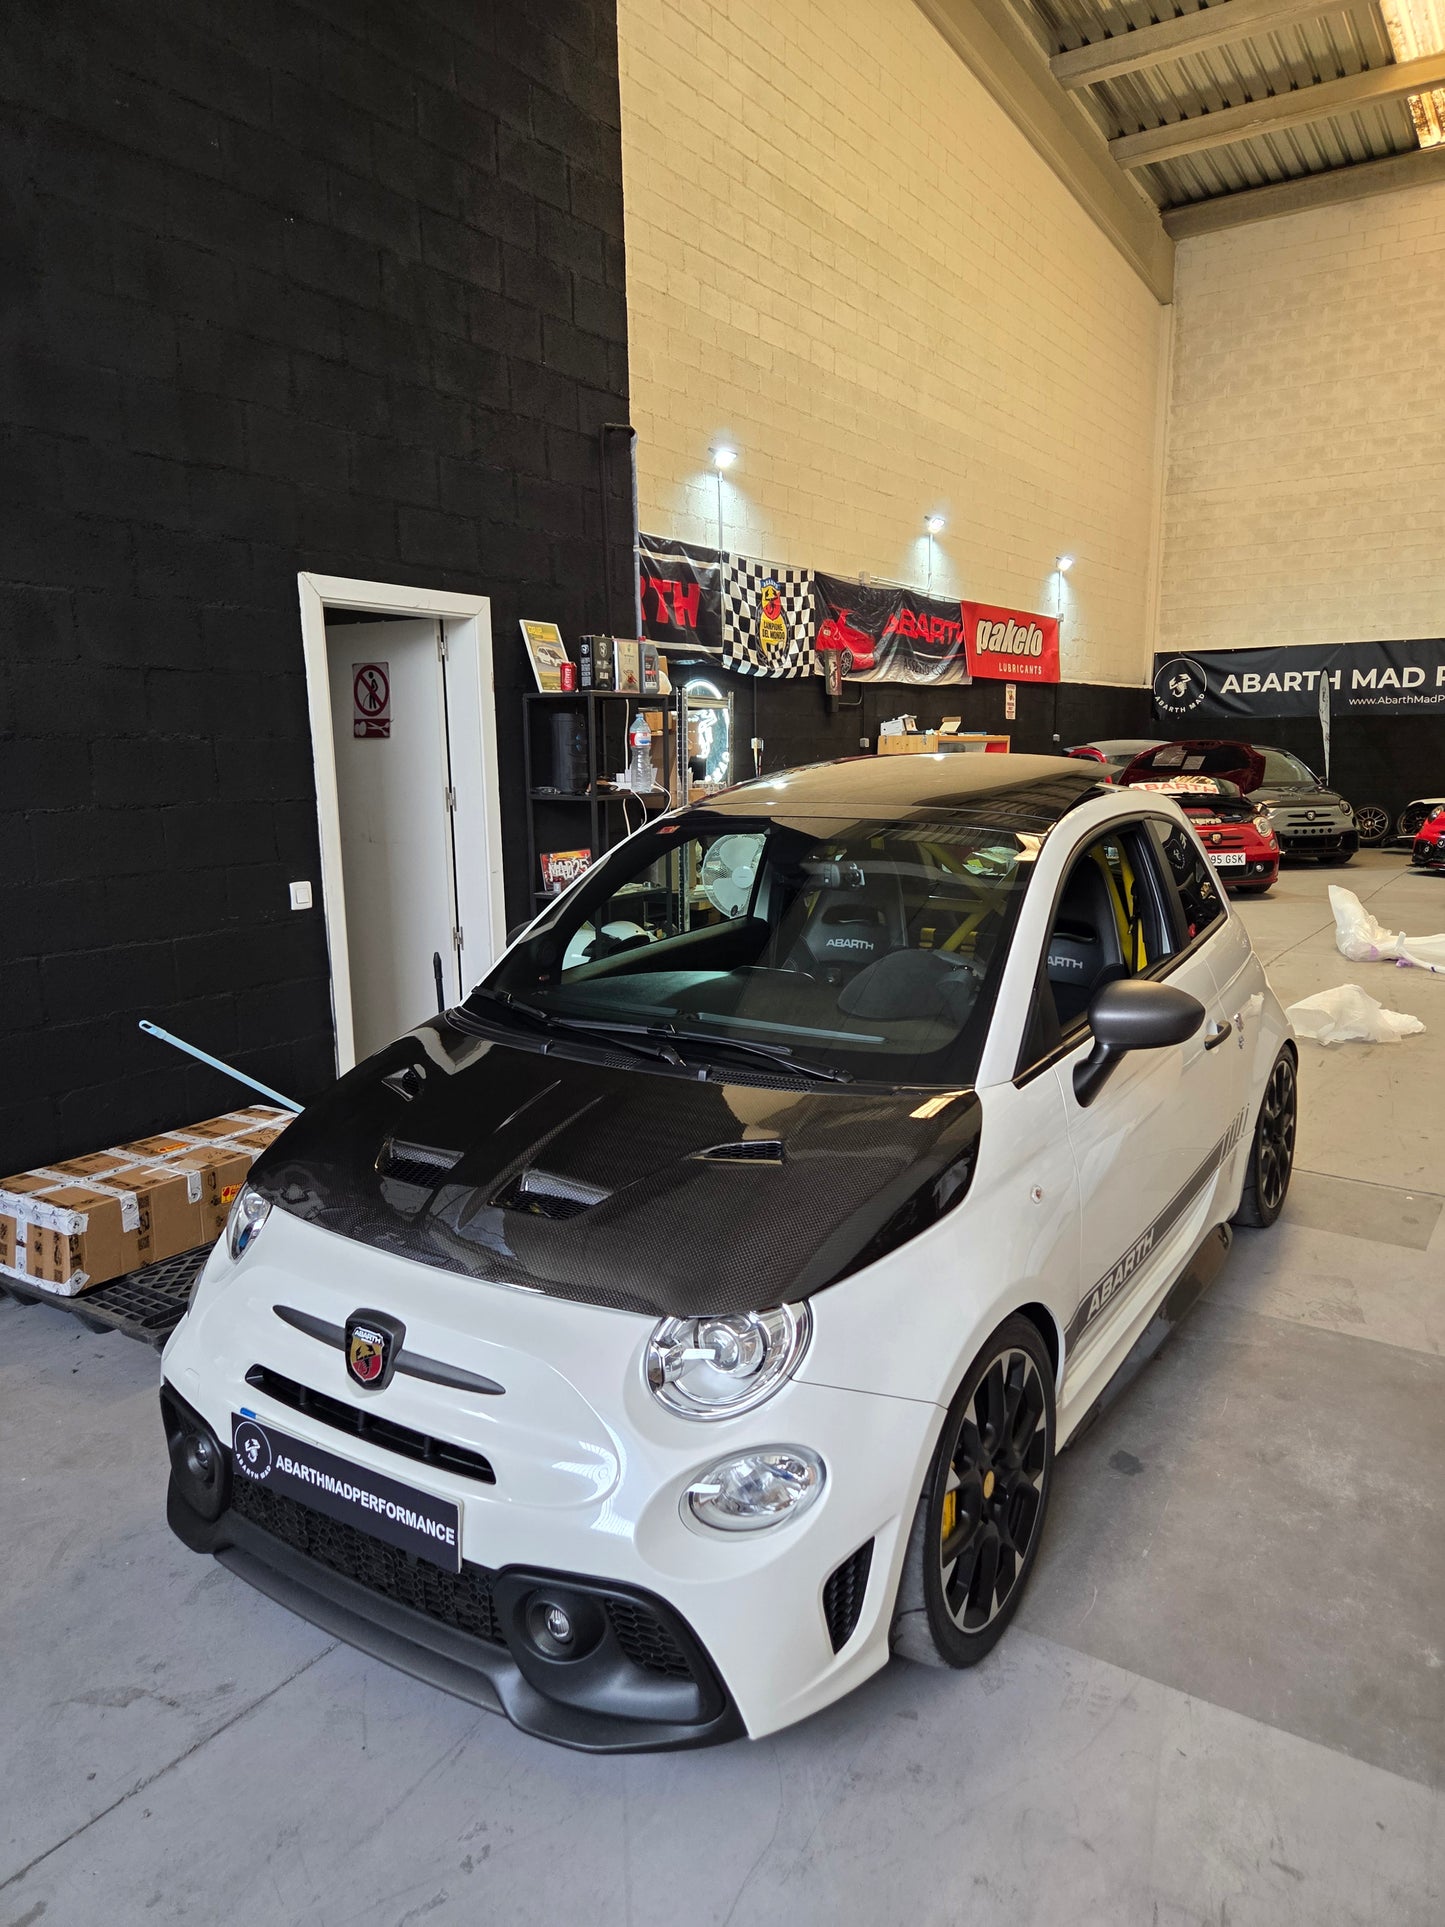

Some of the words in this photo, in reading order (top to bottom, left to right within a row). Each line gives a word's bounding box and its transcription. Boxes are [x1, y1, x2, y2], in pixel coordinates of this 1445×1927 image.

[976, 617, 1043, 657] pakelo
[998, 662, 1043, 675] LUBRICANTS
[1219, 670, 1342, 694] ABARTH
[1351, 667, 1426, 690] MAD
[1154, 696, 1186, 713] ABARTH
[1188, 693, 1206, 710] MAD
[1225, 854, 1244, 864] GSK
[826, 938, 874, 951] ABARTH
[1086, 1227, 1155, 1321] ABARTH
[354, 1329, 381, 1344] ABARTH
[236, 1453, 259, 1480] ABARTH
[260, 1465, 271, 1480] MAD
[276, 1454, 455, 1546] ABARTHMADPERFORMANCE
